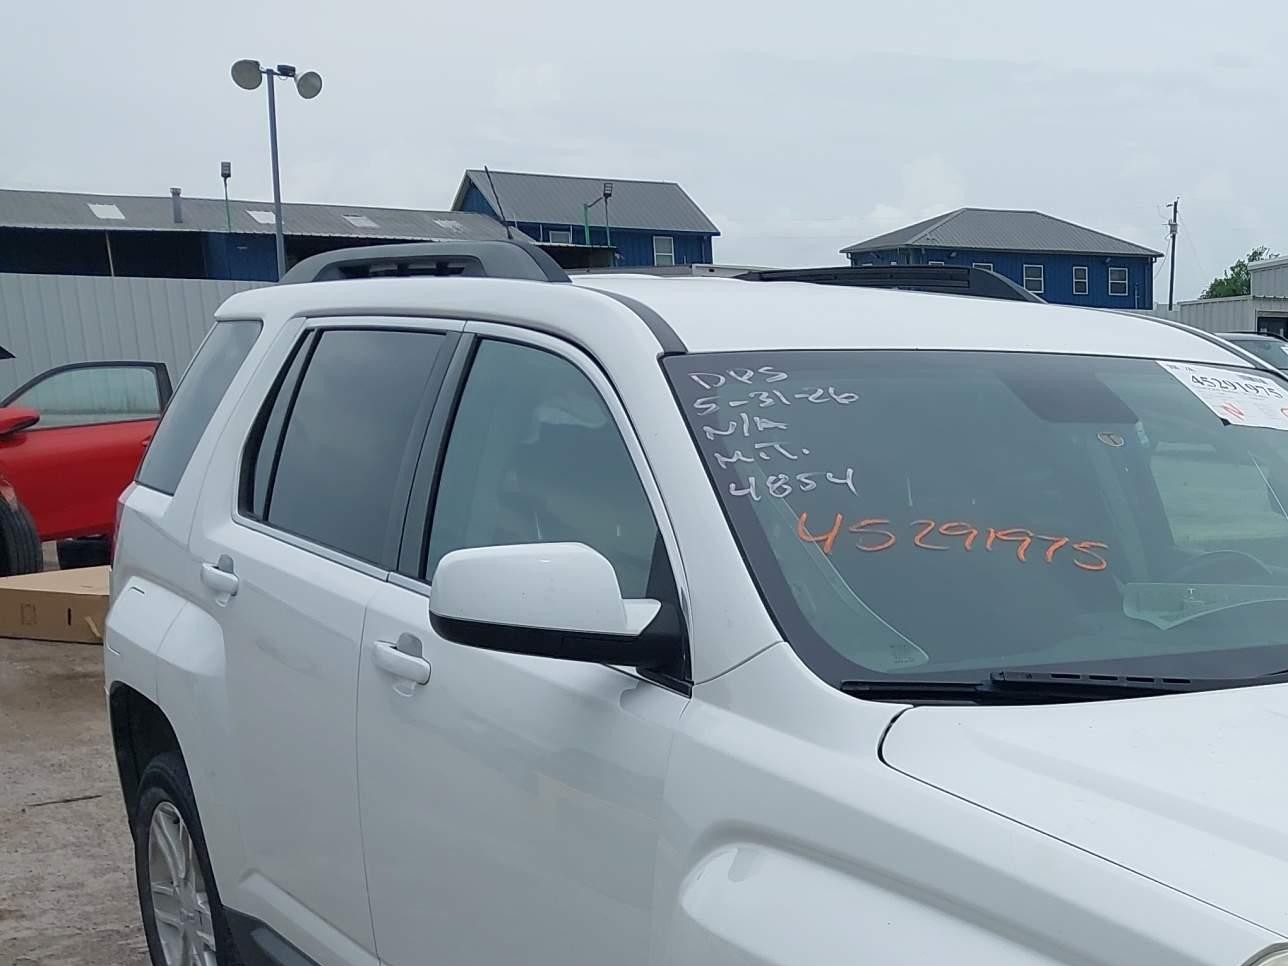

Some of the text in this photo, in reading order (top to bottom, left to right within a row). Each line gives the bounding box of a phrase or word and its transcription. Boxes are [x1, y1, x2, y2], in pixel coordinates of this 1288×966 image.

[693, 386, 860, 416] 5-31-26
[1190, 374, 1284, 400] 45291975
[728, 467, 859, 501] 4854
[797, 512, 1109, 571] 45291975
